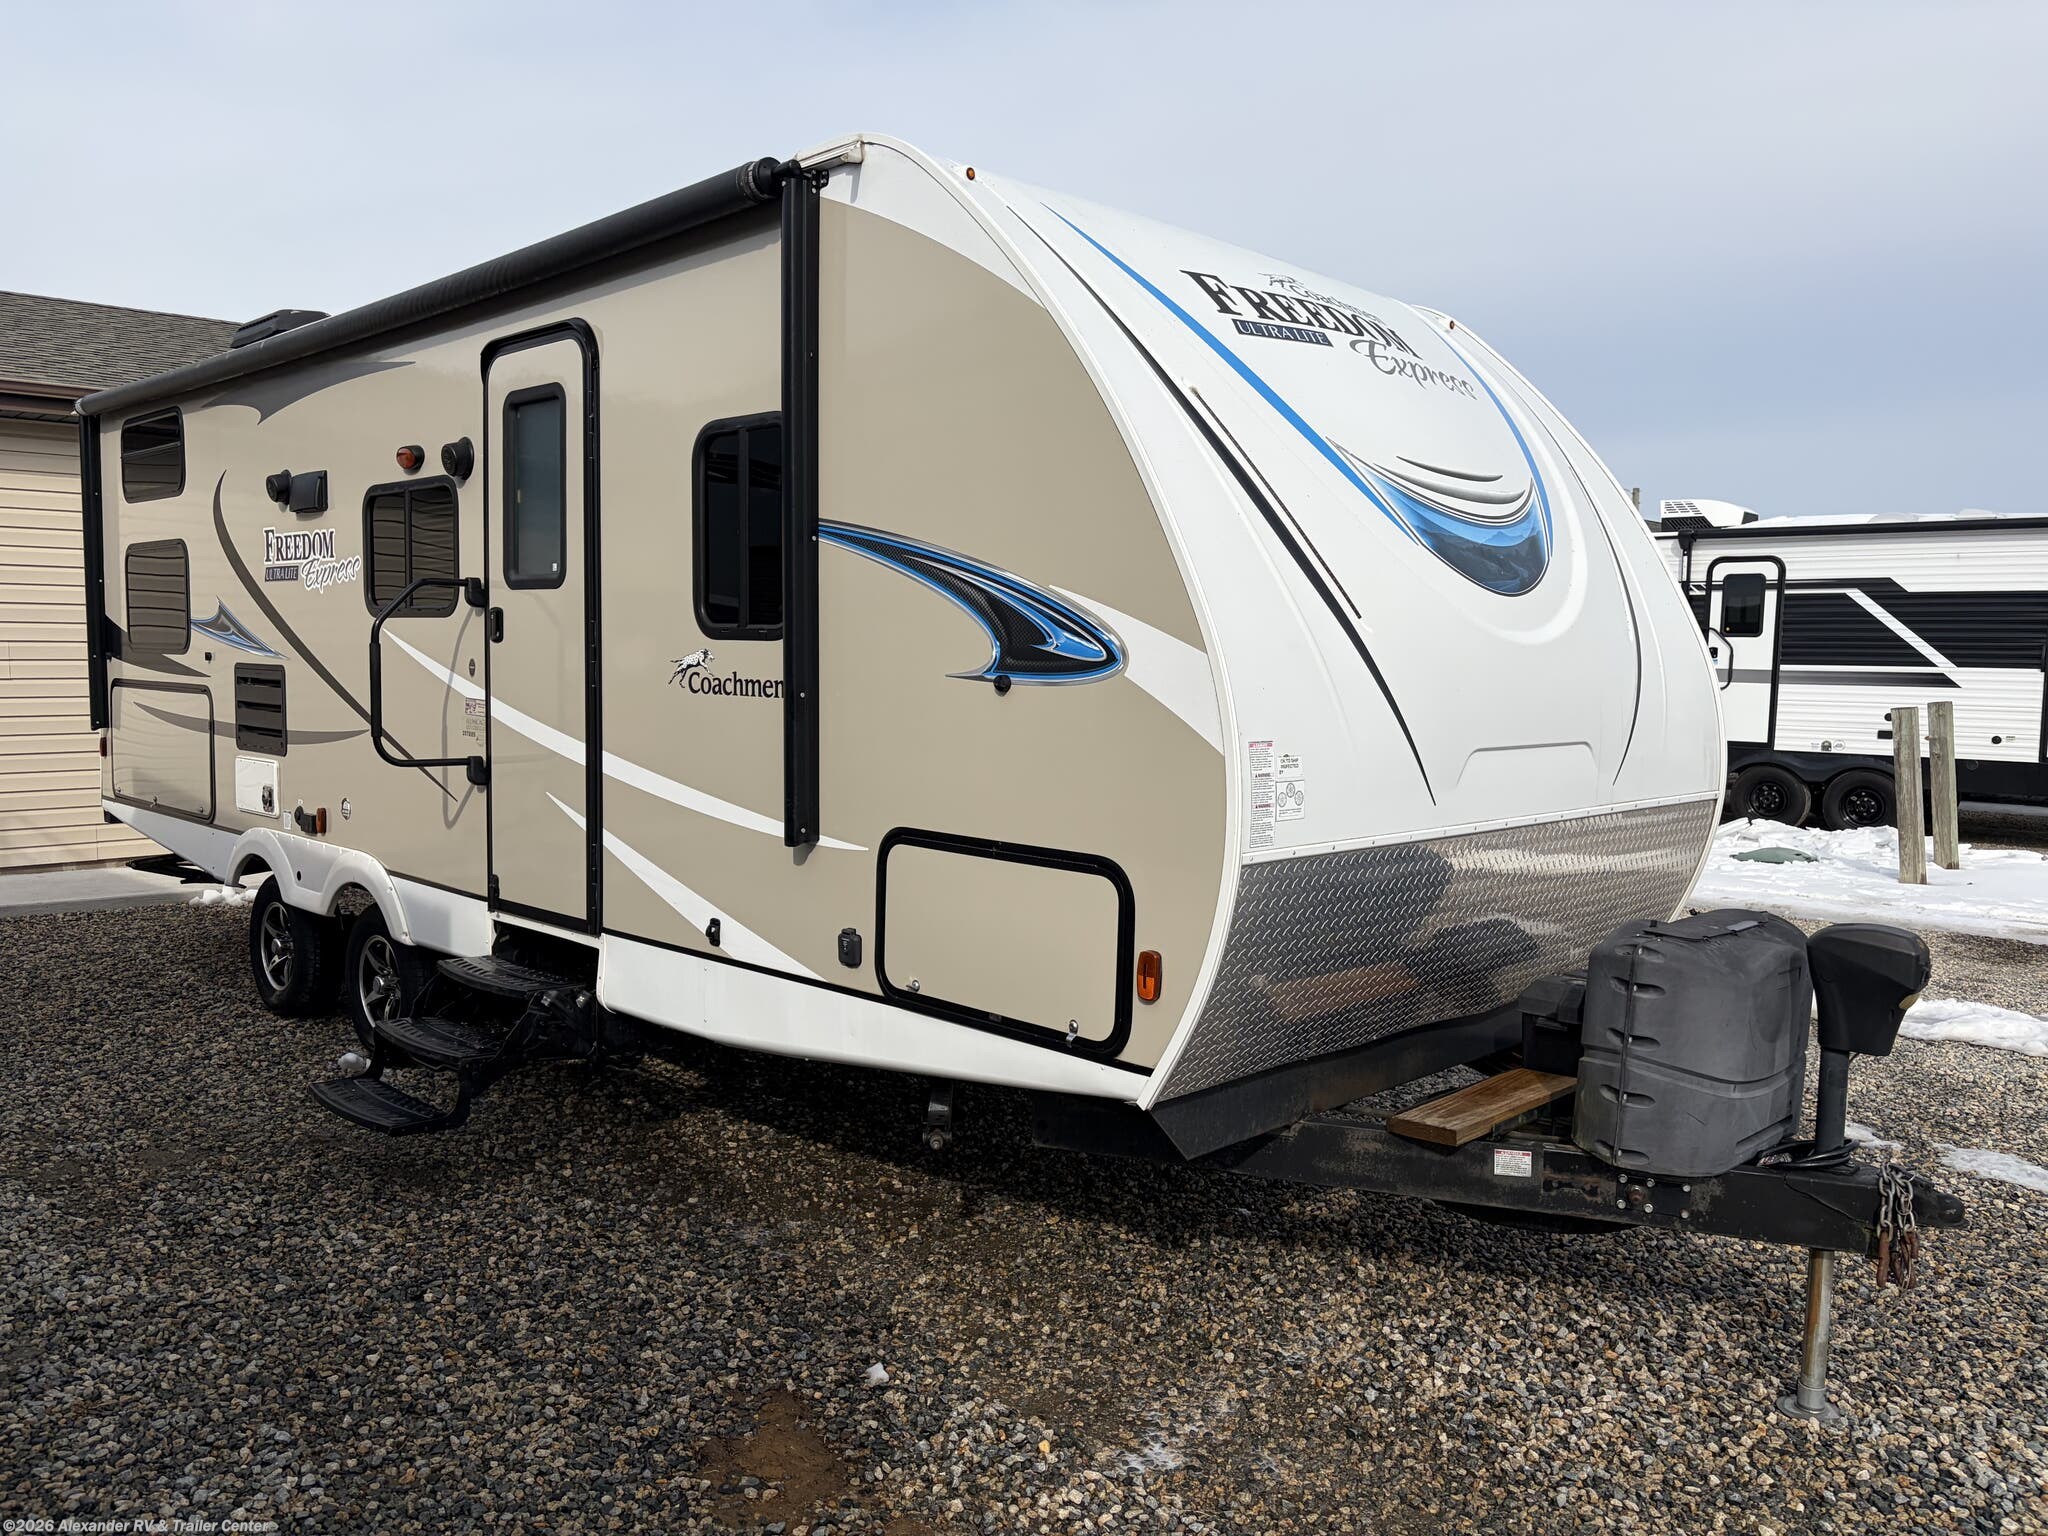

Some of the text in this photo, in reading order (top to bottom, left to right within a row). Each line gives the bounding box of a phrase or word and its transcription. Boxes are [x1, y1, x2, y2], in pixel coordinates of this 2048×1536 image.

[1179, 270, 1424, 360] FREEDOM
[1350, 339, 1478, 401] Express
[264, 529, 335, 562] FREEDOM
[302, 557, 360, 592] Express
[688, 671, 784, 698] Coachmen
